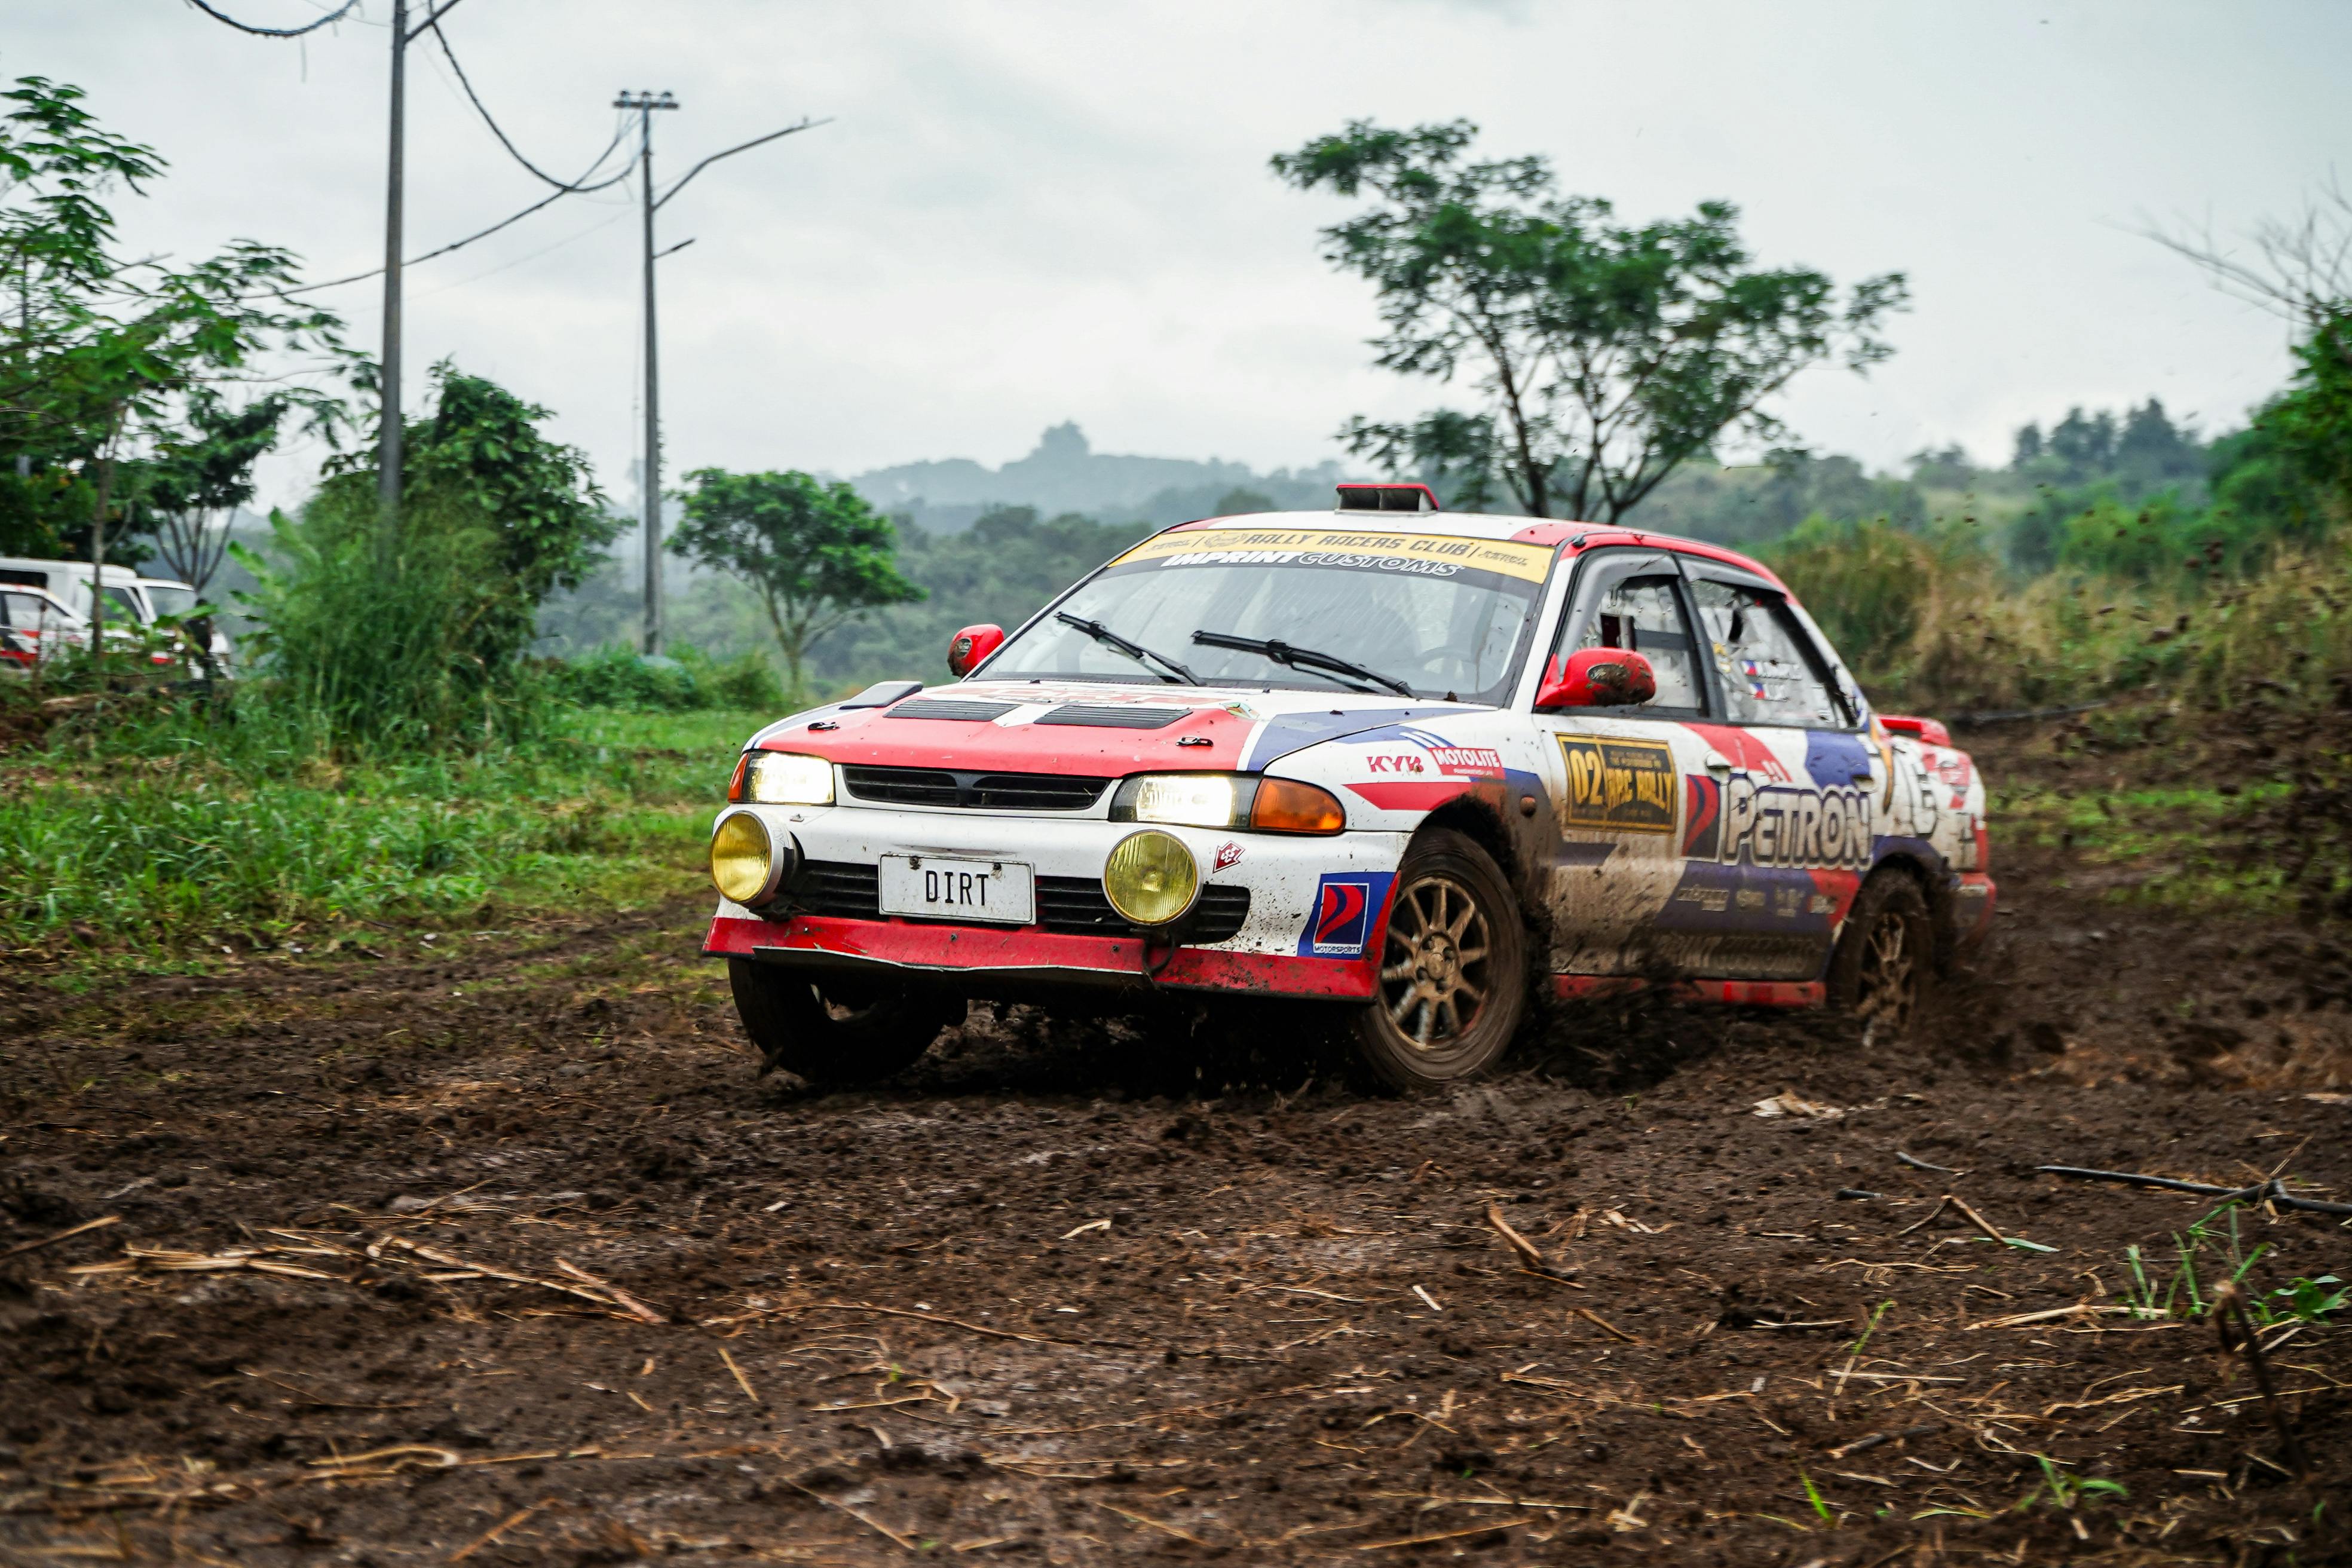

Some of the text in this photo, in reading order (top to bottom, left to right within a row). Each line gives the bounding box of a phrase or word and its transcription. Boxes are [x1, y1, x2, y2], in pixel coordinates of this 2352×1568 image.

[1316, 535, 1406, 549] RACERS
[1409, 540, 1471, 556] CLUB
[1160, 551, 1306, 567] IMPRINT
[1298, 552, 1463, 577] CUSTOMS
[1366, 755, 1425, 773] KYB
[1432, 749, 1500, 768] MOTOLITE
[1569, 749, 1604, 805] 02
[1721, 775, 1875, 869] PETRON
[926, 870, 989, 906] DIRT
[1314, 945, 1362, 954] MOTORSPORTS
